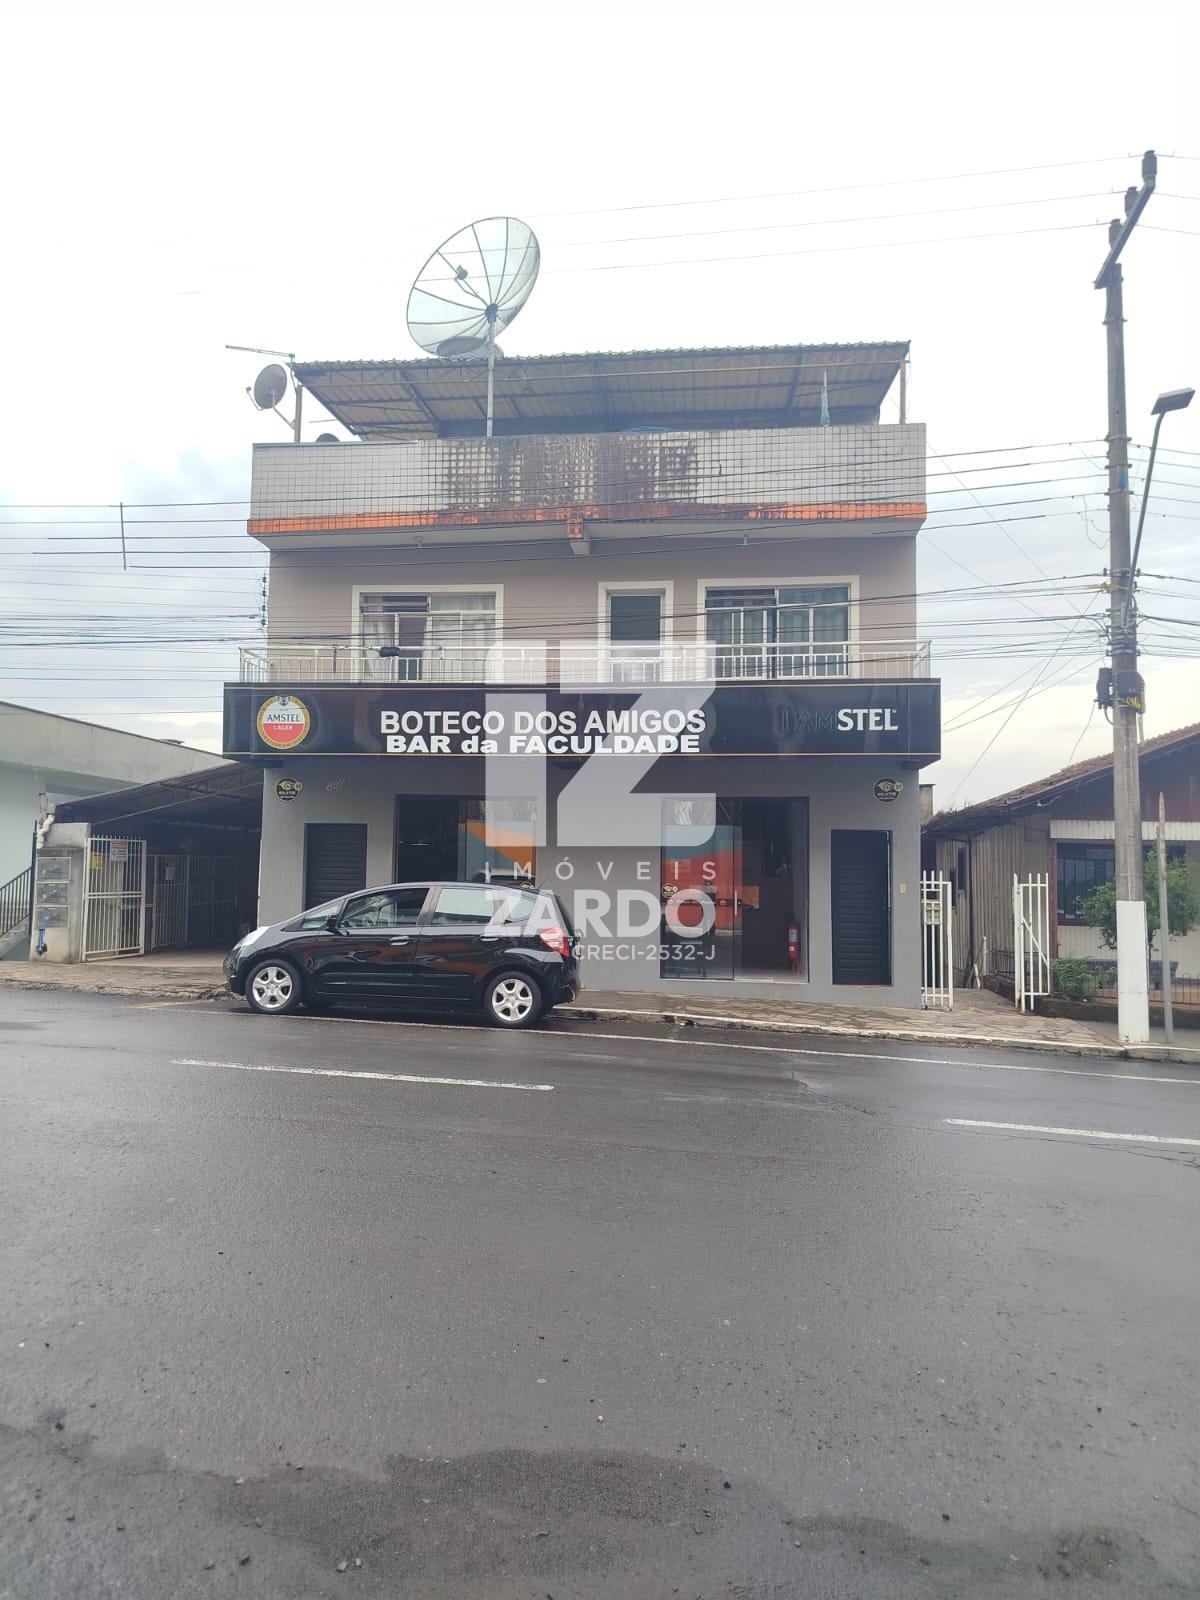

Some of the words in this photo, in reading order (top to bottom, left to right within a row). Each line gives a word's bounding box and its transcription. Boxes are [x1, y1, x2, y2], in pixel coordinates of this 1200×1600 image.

[267, 714, 299, 722] AMSTEL
[380, 710, 505, 735] BOTECO
[514, 710, 577, 735] DOS
[583, 709, 706, 734] AMIGOS
[386, 735, 452, 753] BAR
[460, 736, 498, 753] da
[509, 735, 700, 753] FACULDADE
